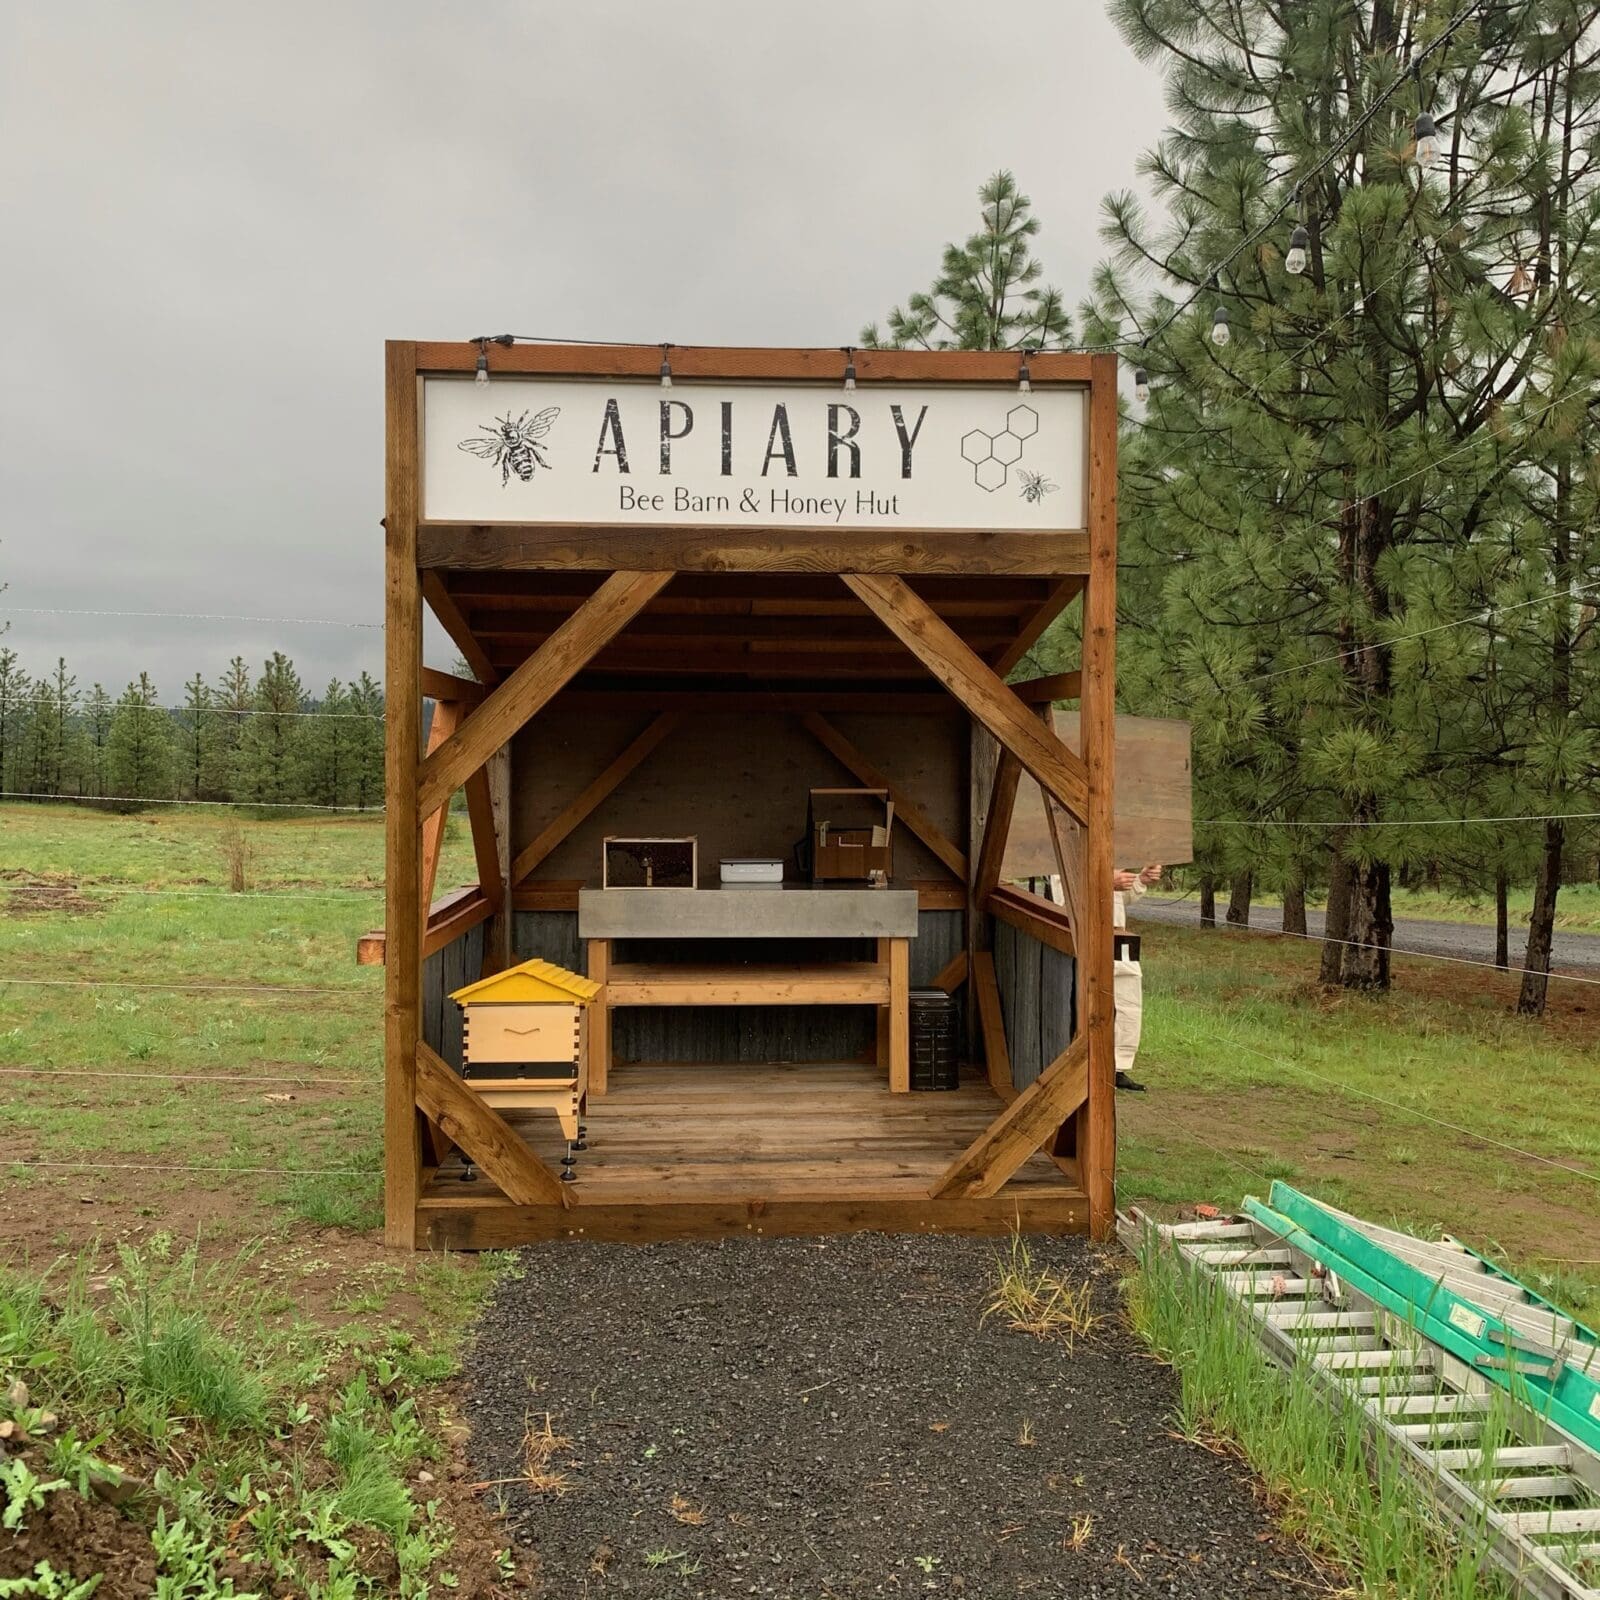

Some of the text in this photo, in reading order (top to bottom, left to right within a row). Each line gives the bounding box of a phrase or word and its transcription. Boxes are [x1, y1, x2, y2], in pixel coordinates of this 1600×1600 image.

[592, 398, 929, 479] APIARY
[620, 486, 900, 523] Bee Barn & Honey Hut
